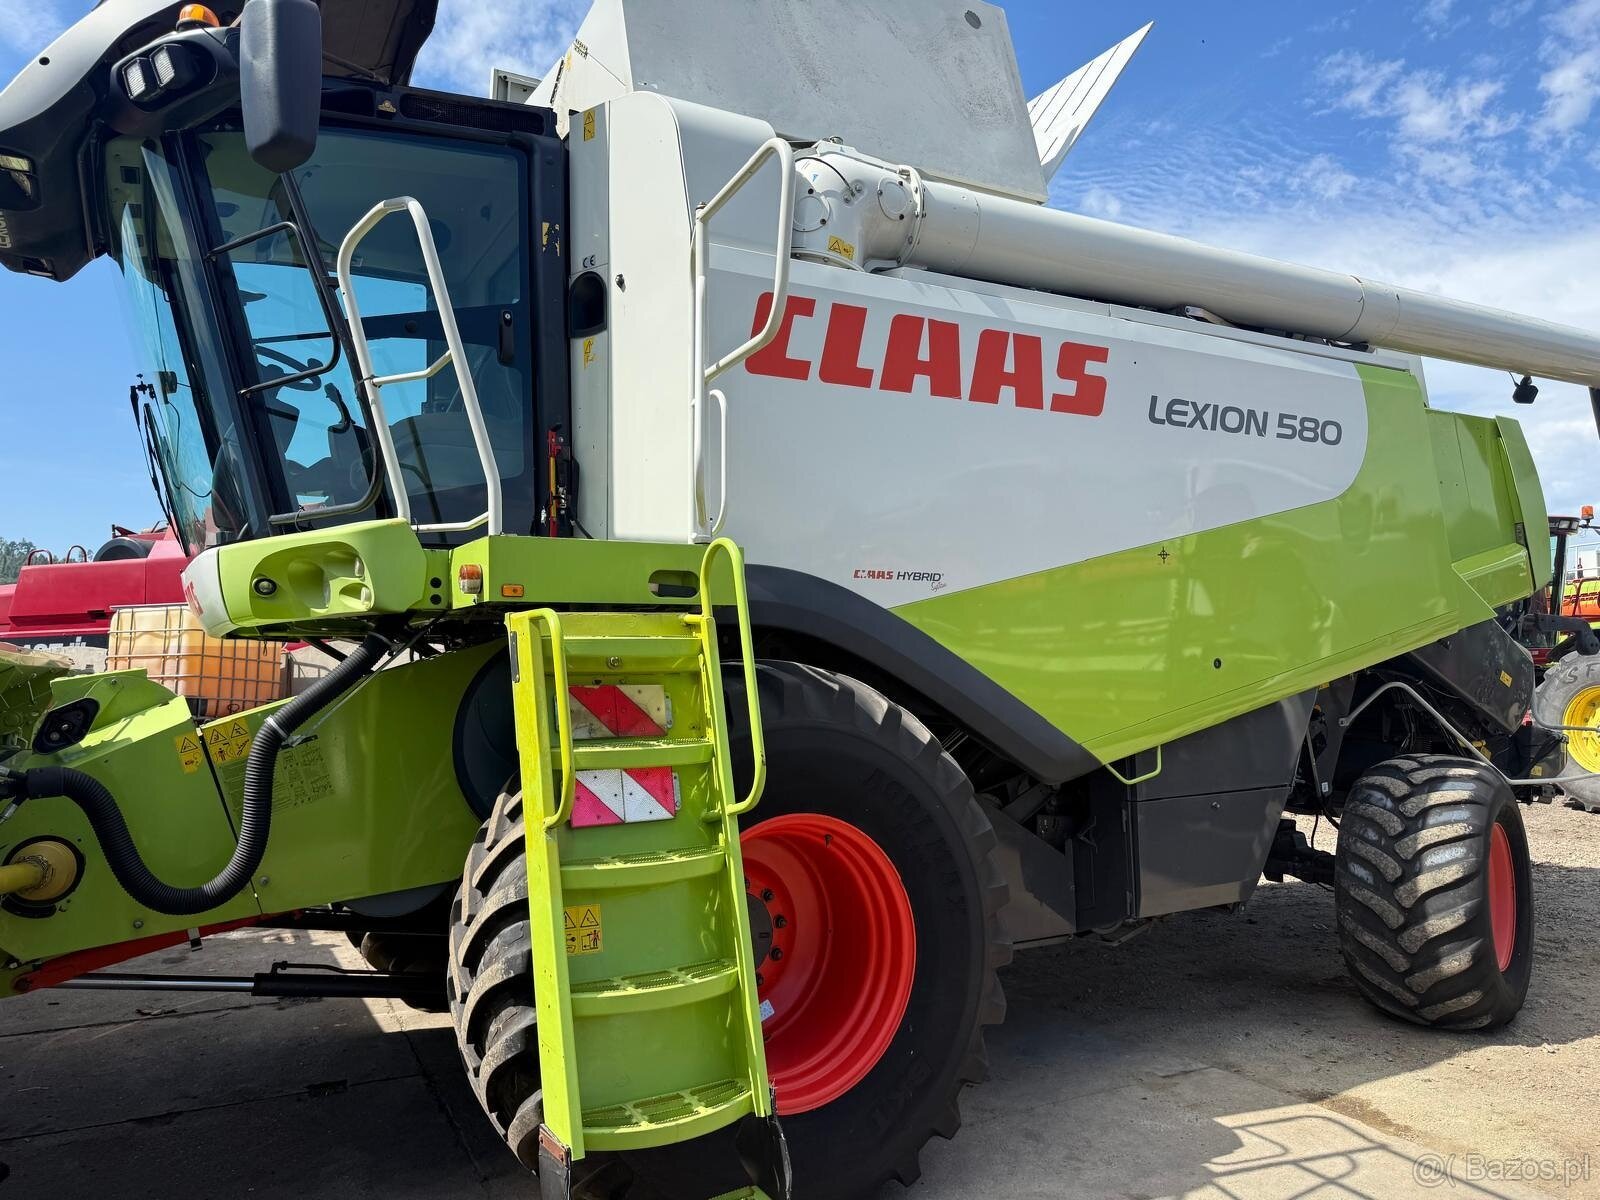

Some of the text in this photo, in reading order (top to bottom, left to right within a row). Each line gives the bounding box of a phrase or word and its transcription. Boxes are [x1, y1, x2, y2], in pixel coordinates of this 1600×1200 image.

[745, 292, 1109, 416] CLAAS
[1149, 395, 1342, 446] LEXION 580
[897, 571, 941, 582] HYBRID
